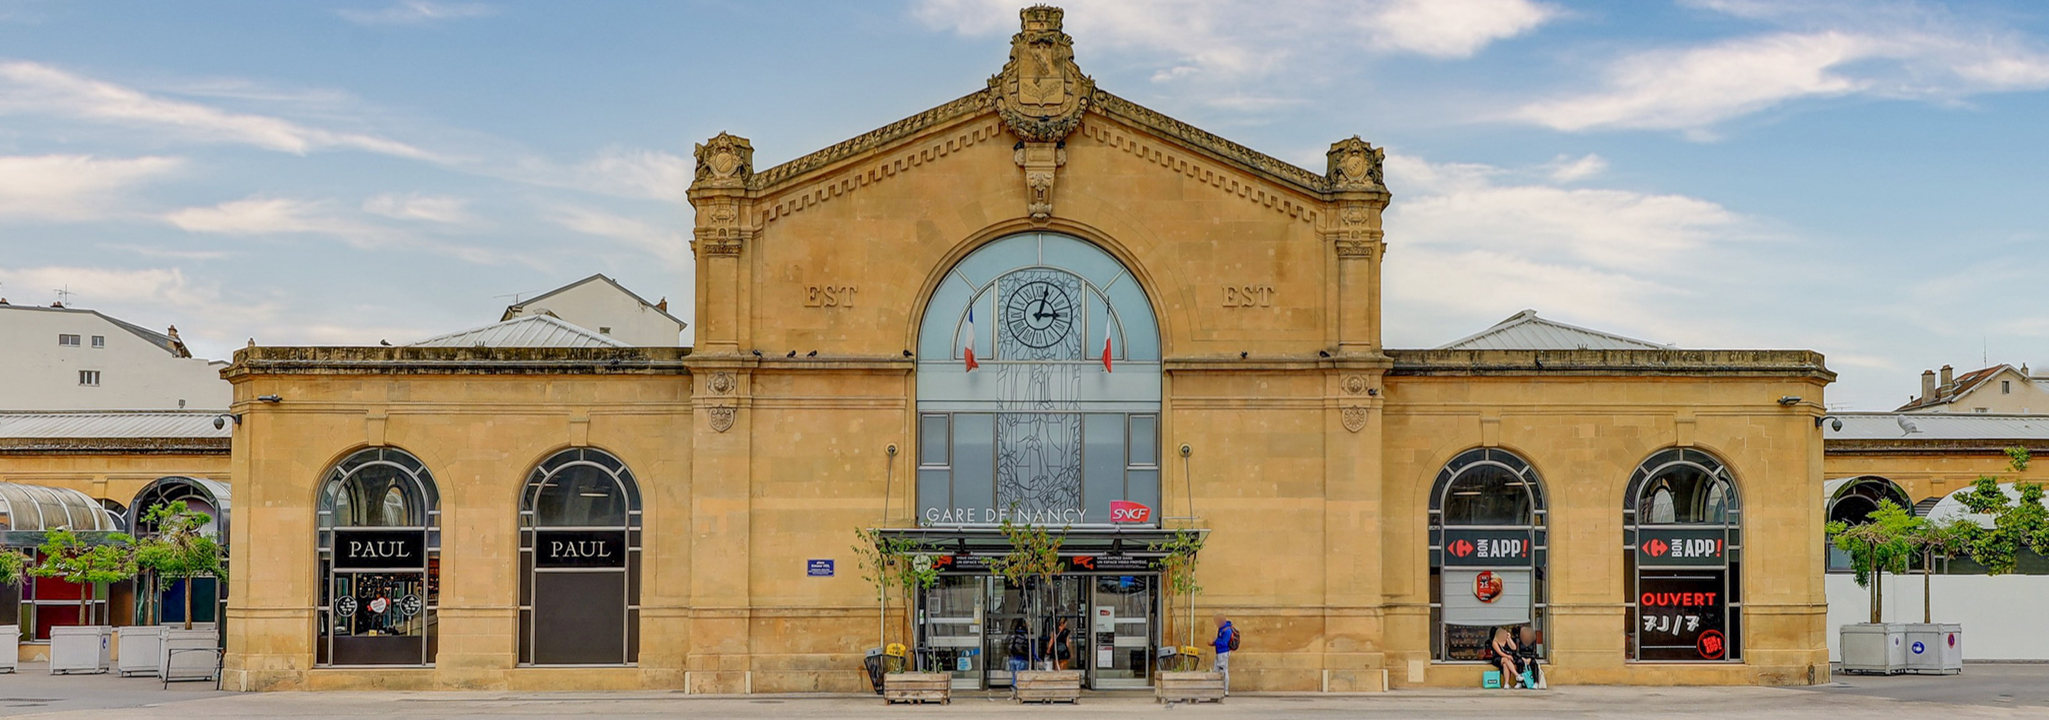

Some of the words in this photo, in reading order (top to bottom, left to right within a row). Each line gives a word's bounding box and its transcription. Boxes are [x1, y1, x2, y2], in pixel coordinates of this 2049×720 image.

[803, 284, 858, 308] EST
[1221, 284, 1275, 308] EST
[926, 507, 975, 522] GARE
[1018, 508, 1087, 523] NANCY
[1112, 508, 1148, 519] SNCF
[349, 541, 410, 557] PAUL
[550, 541, 611, 557] PAUL
[1477, 539, 1488, 557] BON
[1490, 539, 1528, 558] APP!
[1671, 539, 1683, 557] BON
[1684, 539, 1722, 557] APP!
[1641, 592, 1716, 606] OUVERT
[1642, 614, 1700, 636] 7J/7
[1703, 635, 1717, 646] BON
